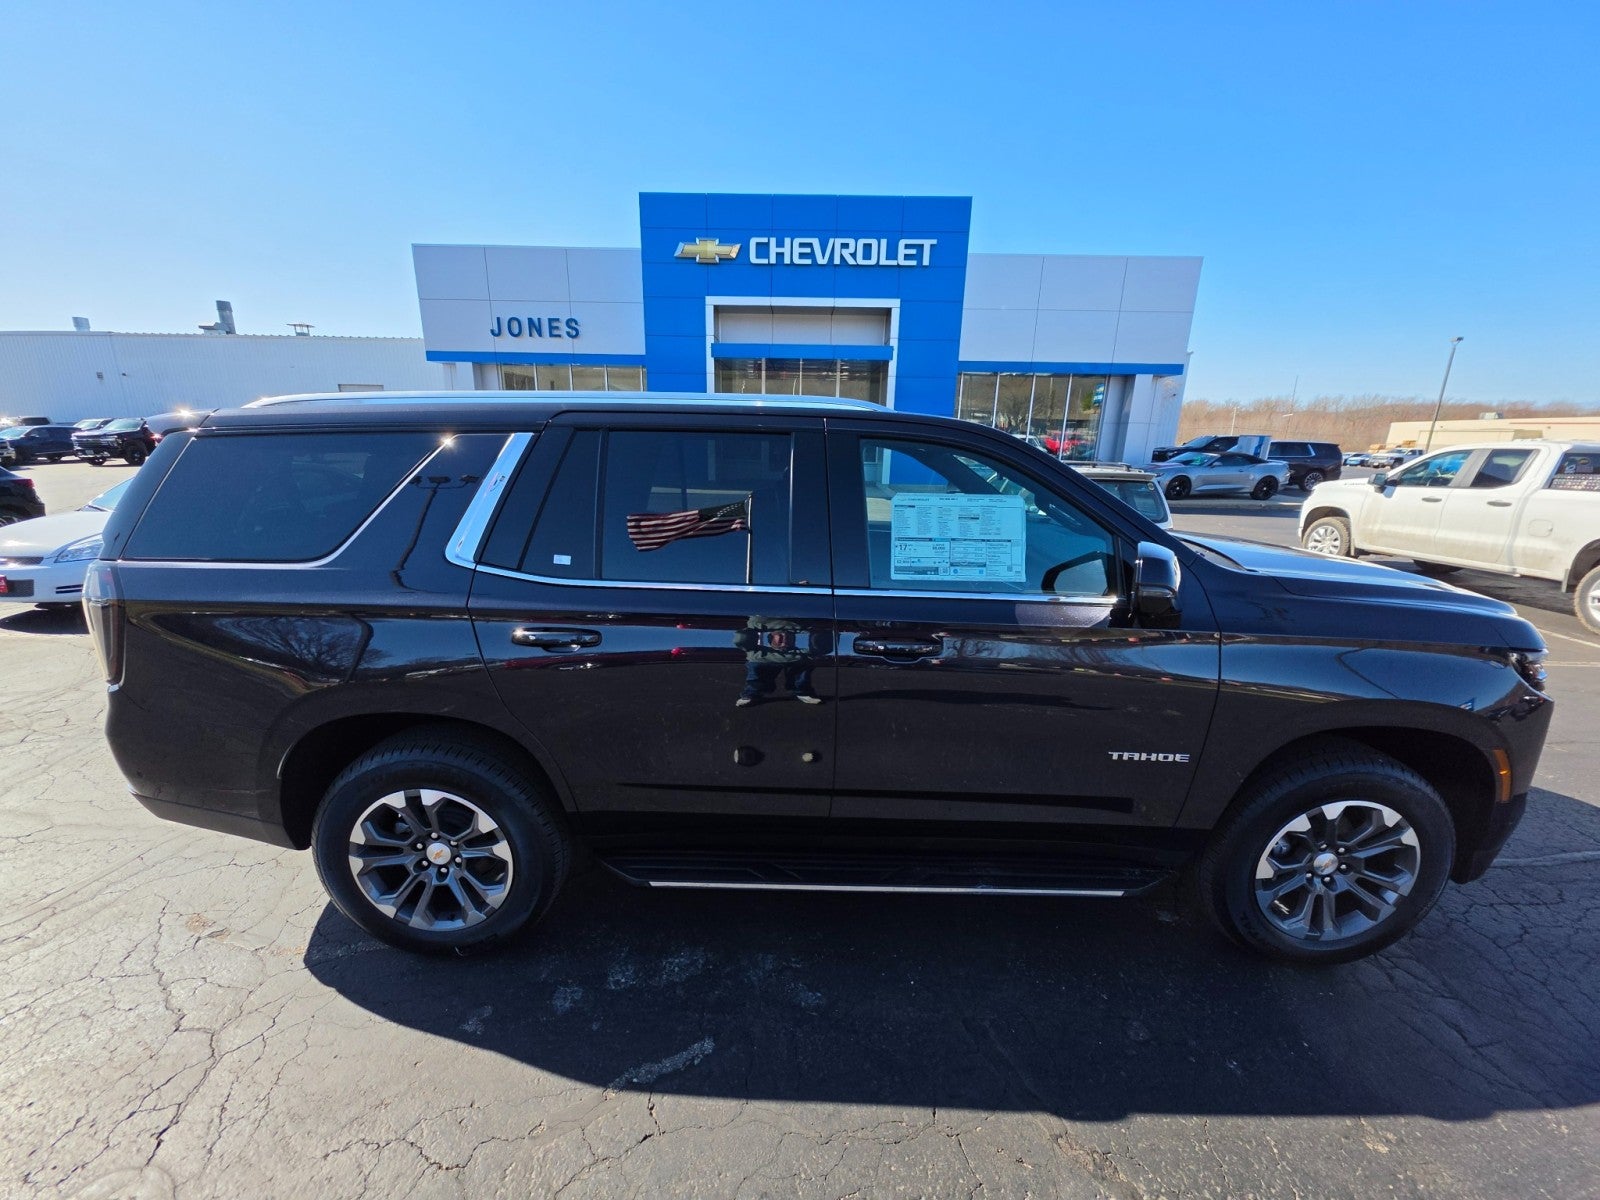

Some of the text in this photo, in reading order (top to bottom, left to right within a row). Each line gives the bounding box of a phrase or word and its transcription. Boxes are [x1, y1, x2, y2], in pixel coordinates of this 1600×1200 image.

[749, 237, 938, 267] CHEVROLET
[490, 316, 580, 339] JONES
[1108, 751, 1190, 762] TAHOE
